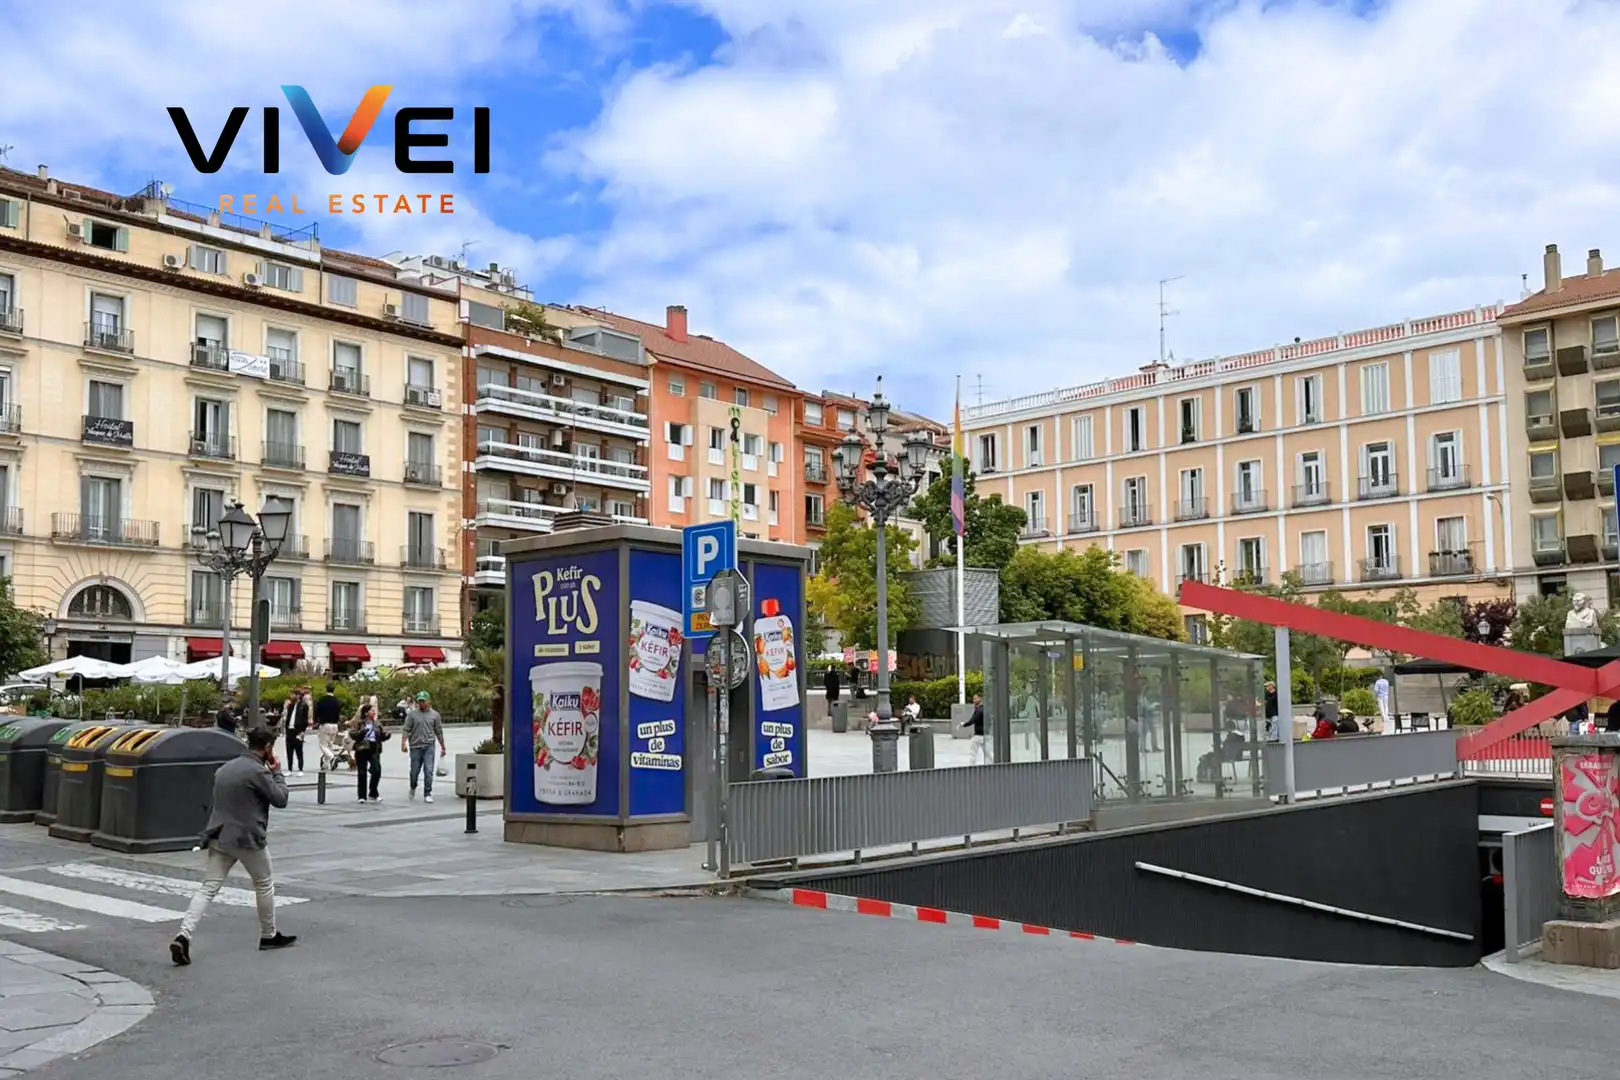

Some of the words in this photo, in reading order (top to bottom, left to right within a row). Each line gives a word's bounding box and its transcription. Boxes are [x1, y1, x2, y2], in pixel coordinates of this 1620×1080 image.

[697, 535, 719, 575] P
[532, 571, 601, 635] PLUS
[552, 694, 579, 709] Kaiku
[548, 718, 584, 736] KÉFIR
[639, 726, 653, 735] un
[653, 721, 673, 737] plus
[763, 724, 774, 733] un
[775, 723, 792, 737] plus
[651, 738, 663, 751] de
[773, 739, 783, 749] de
[633, 753, 680, 768] vitaminas
[766, 753, 790, 766] sabor
